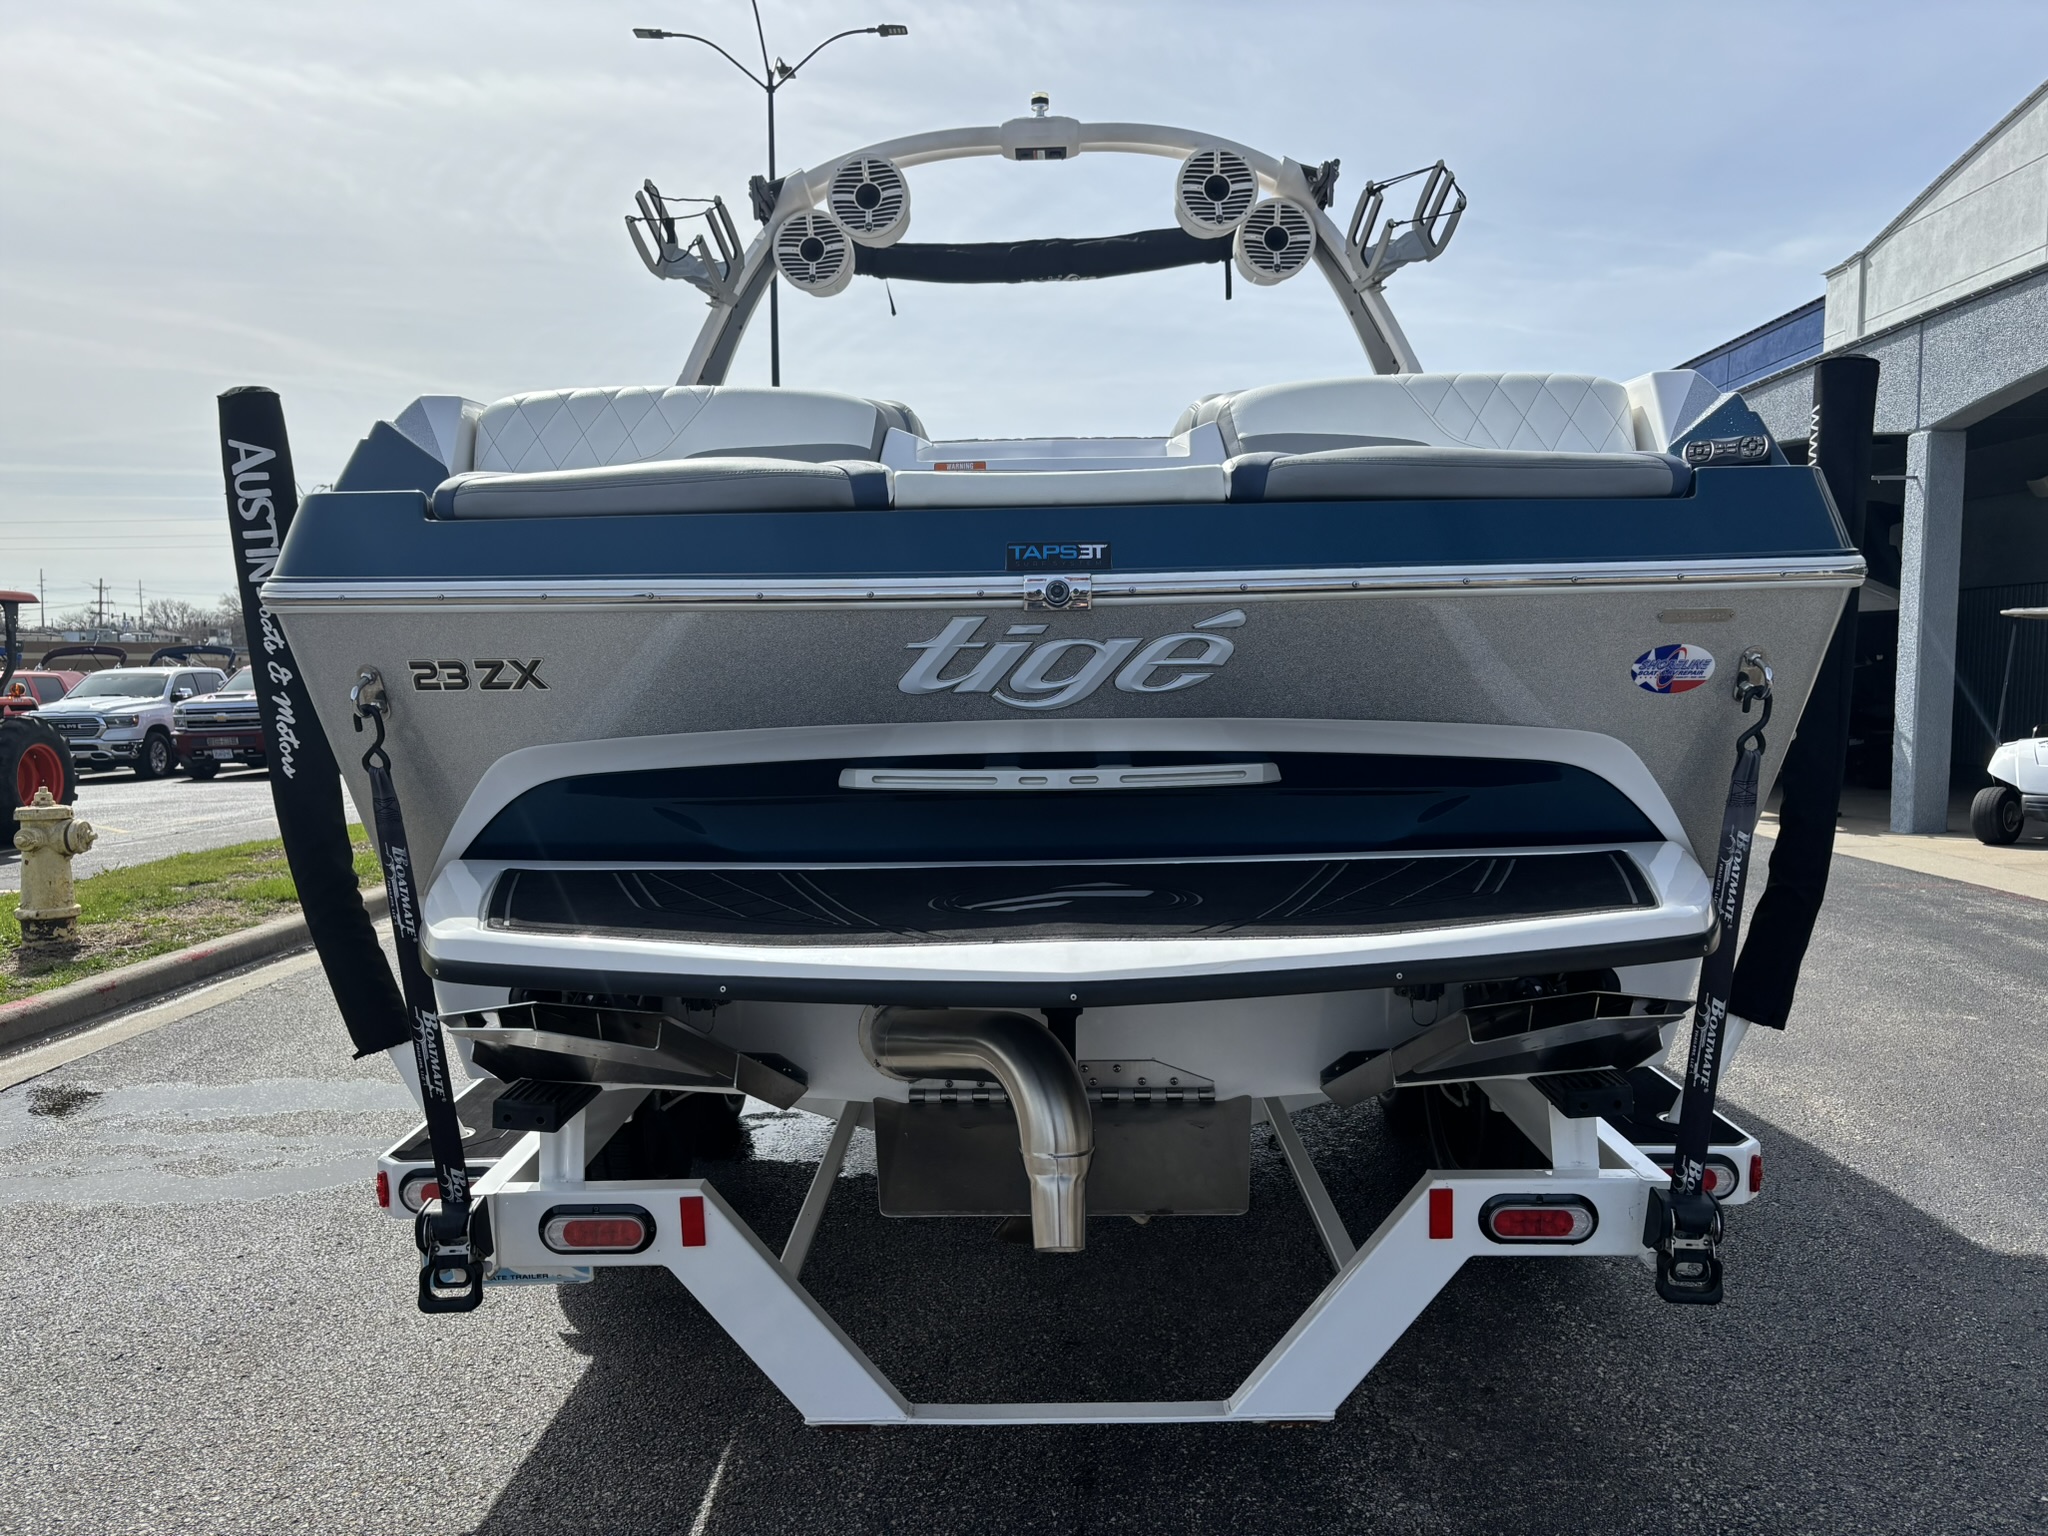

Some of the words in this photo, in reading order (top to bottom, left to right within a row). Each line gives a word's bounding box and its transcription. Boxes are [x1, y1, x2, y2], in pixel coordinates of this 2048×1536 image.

[227, 438, 280, 583] AUSTIN
[255, 587, 285, 655] oats
[267, 661, 293, 687] &
[897, 608, 1247, 711] tigé
[1638, 658, 1713, 670] SHORELINE
[271, 691, 301, 779] Motors
[511, 1273, 549, 1281] TRAILER
